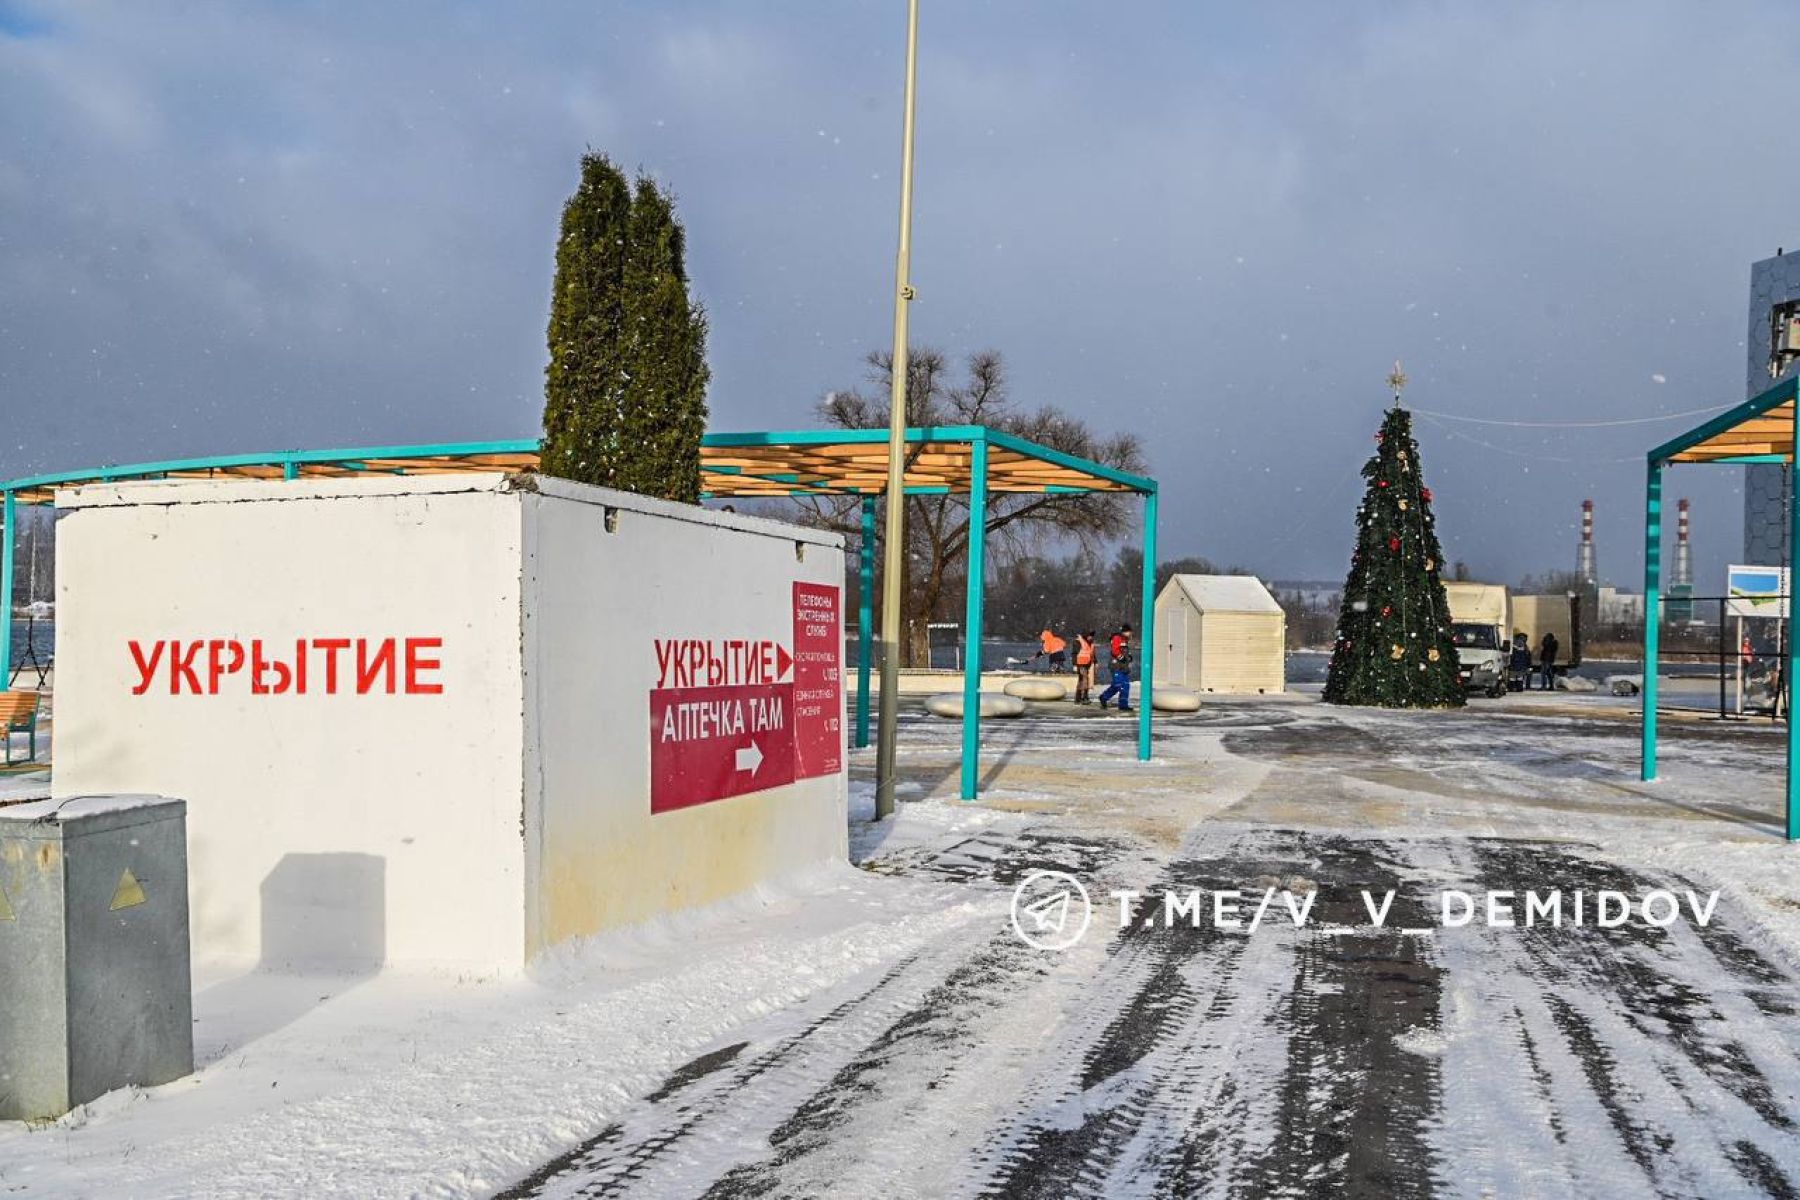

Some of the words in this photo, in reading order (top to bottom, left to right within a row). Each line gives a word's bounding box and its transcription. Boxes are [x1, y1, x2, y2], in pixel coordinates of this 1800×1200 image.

[128, 638, 443, 695] УКРЫТИЕ
[654, 639, 773, 688] УКРЫТИЕ
[661, 699, 745, 743] АПТЕЧКА
[749, 697, 783, 733] ТАМ
